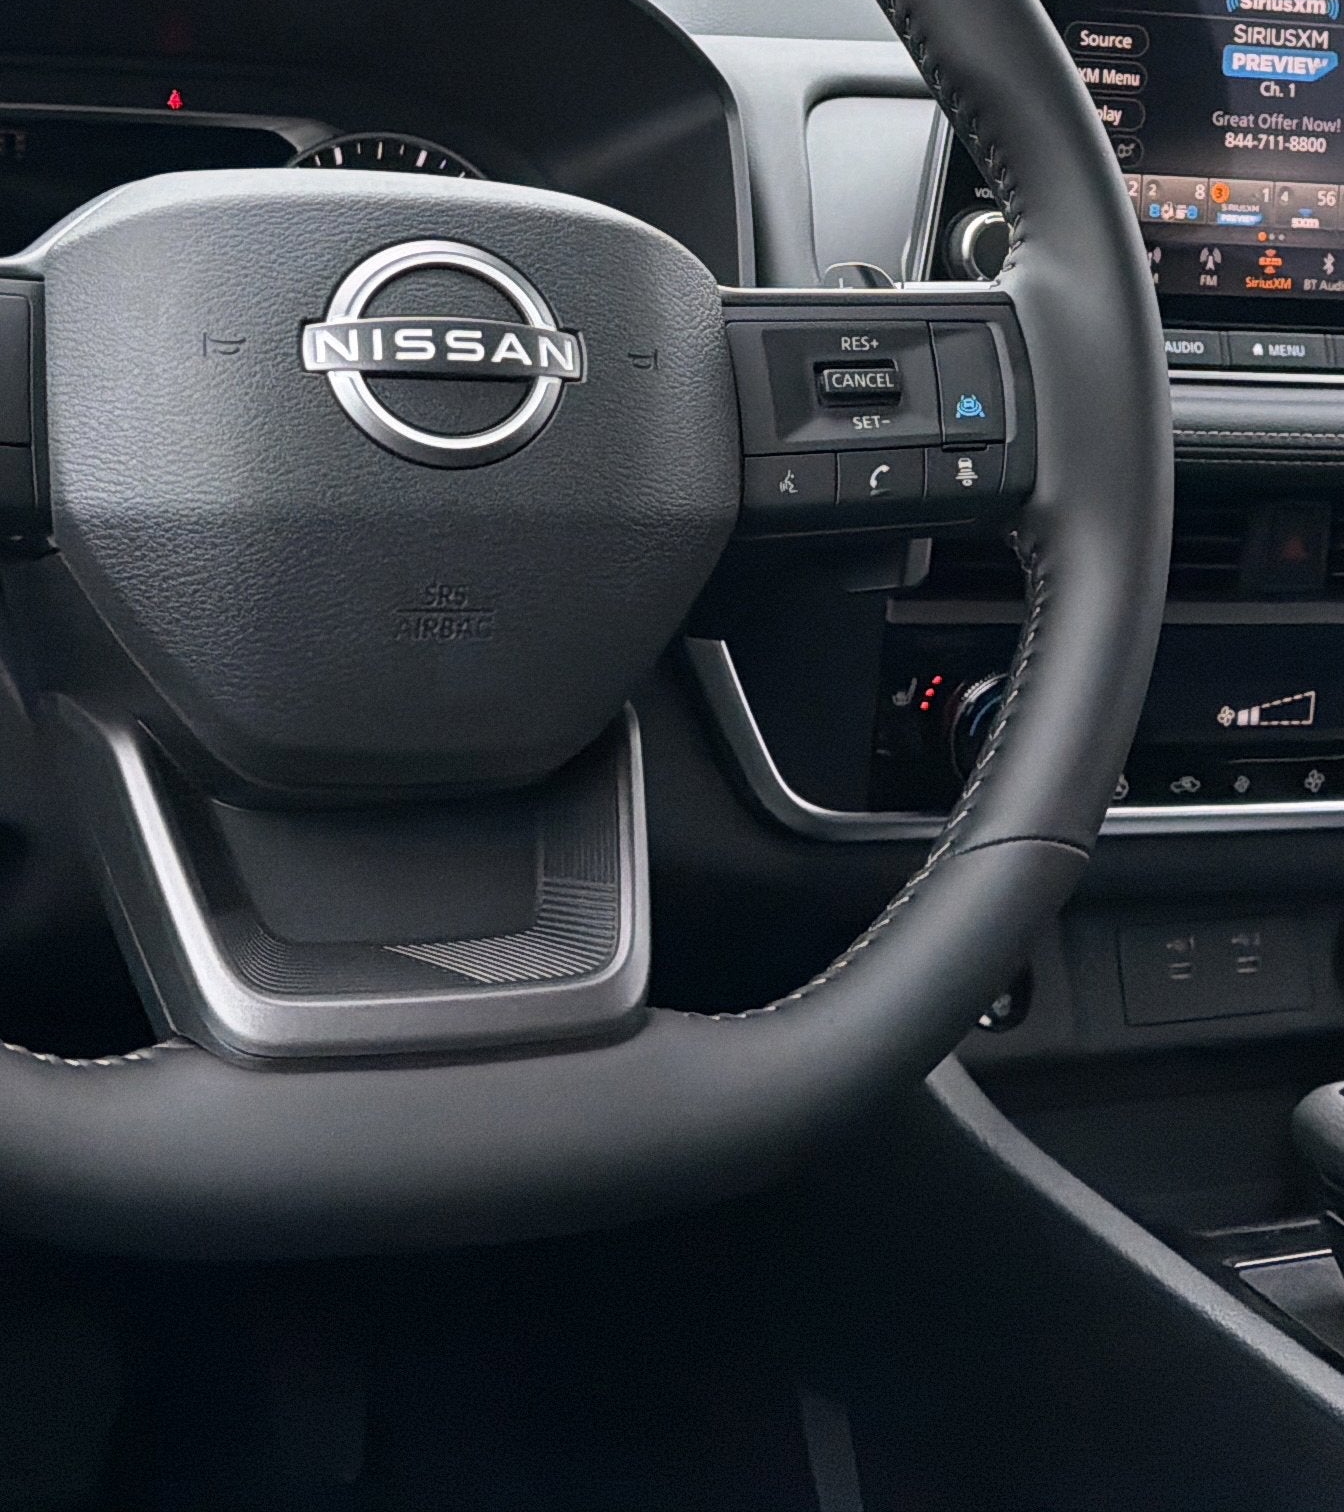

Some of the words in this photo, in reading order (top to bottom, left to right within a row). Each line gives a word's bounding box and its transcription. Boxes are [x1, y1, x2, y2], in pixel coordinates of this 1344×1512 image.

[1080, 29, 1133, 50] Source
[1233, 23, 1330, 50] SIRIUSXM
[1232, 52, 1329, 76] PREVIEW
[1102, 68, 1141, 87] Menu
[1260, 81, 1284, 98] Ch.
[1288, 83, 1296, 99] 1
[1212, 110, 1254, 128] Great
[1258, 113, 1298, 130] Offer
[1302, 116, 1342, 133] Now!
[1224, 131, 1328, 154] 844-711-8800
[1148, 183, 1157, 197] 2
[1194, 183, 1206, 200] 8
[1262, 187, 1270, 203] 1
[1280, 190, 1290, 203] 4
[1317, 190, 1337, 207] 56
[1199, 274, 1218, 286] FM
[1245, 275, 1292, 290] SiriusXM
[1303, 278, 1317, 291] BT
[316, 328, 574, 371] NISSAN
[1164, 340, 1205, 355] AUDIO
[1269, 342, 1306, 358] MENU
[831, 373, 894, 388] CANCEL
